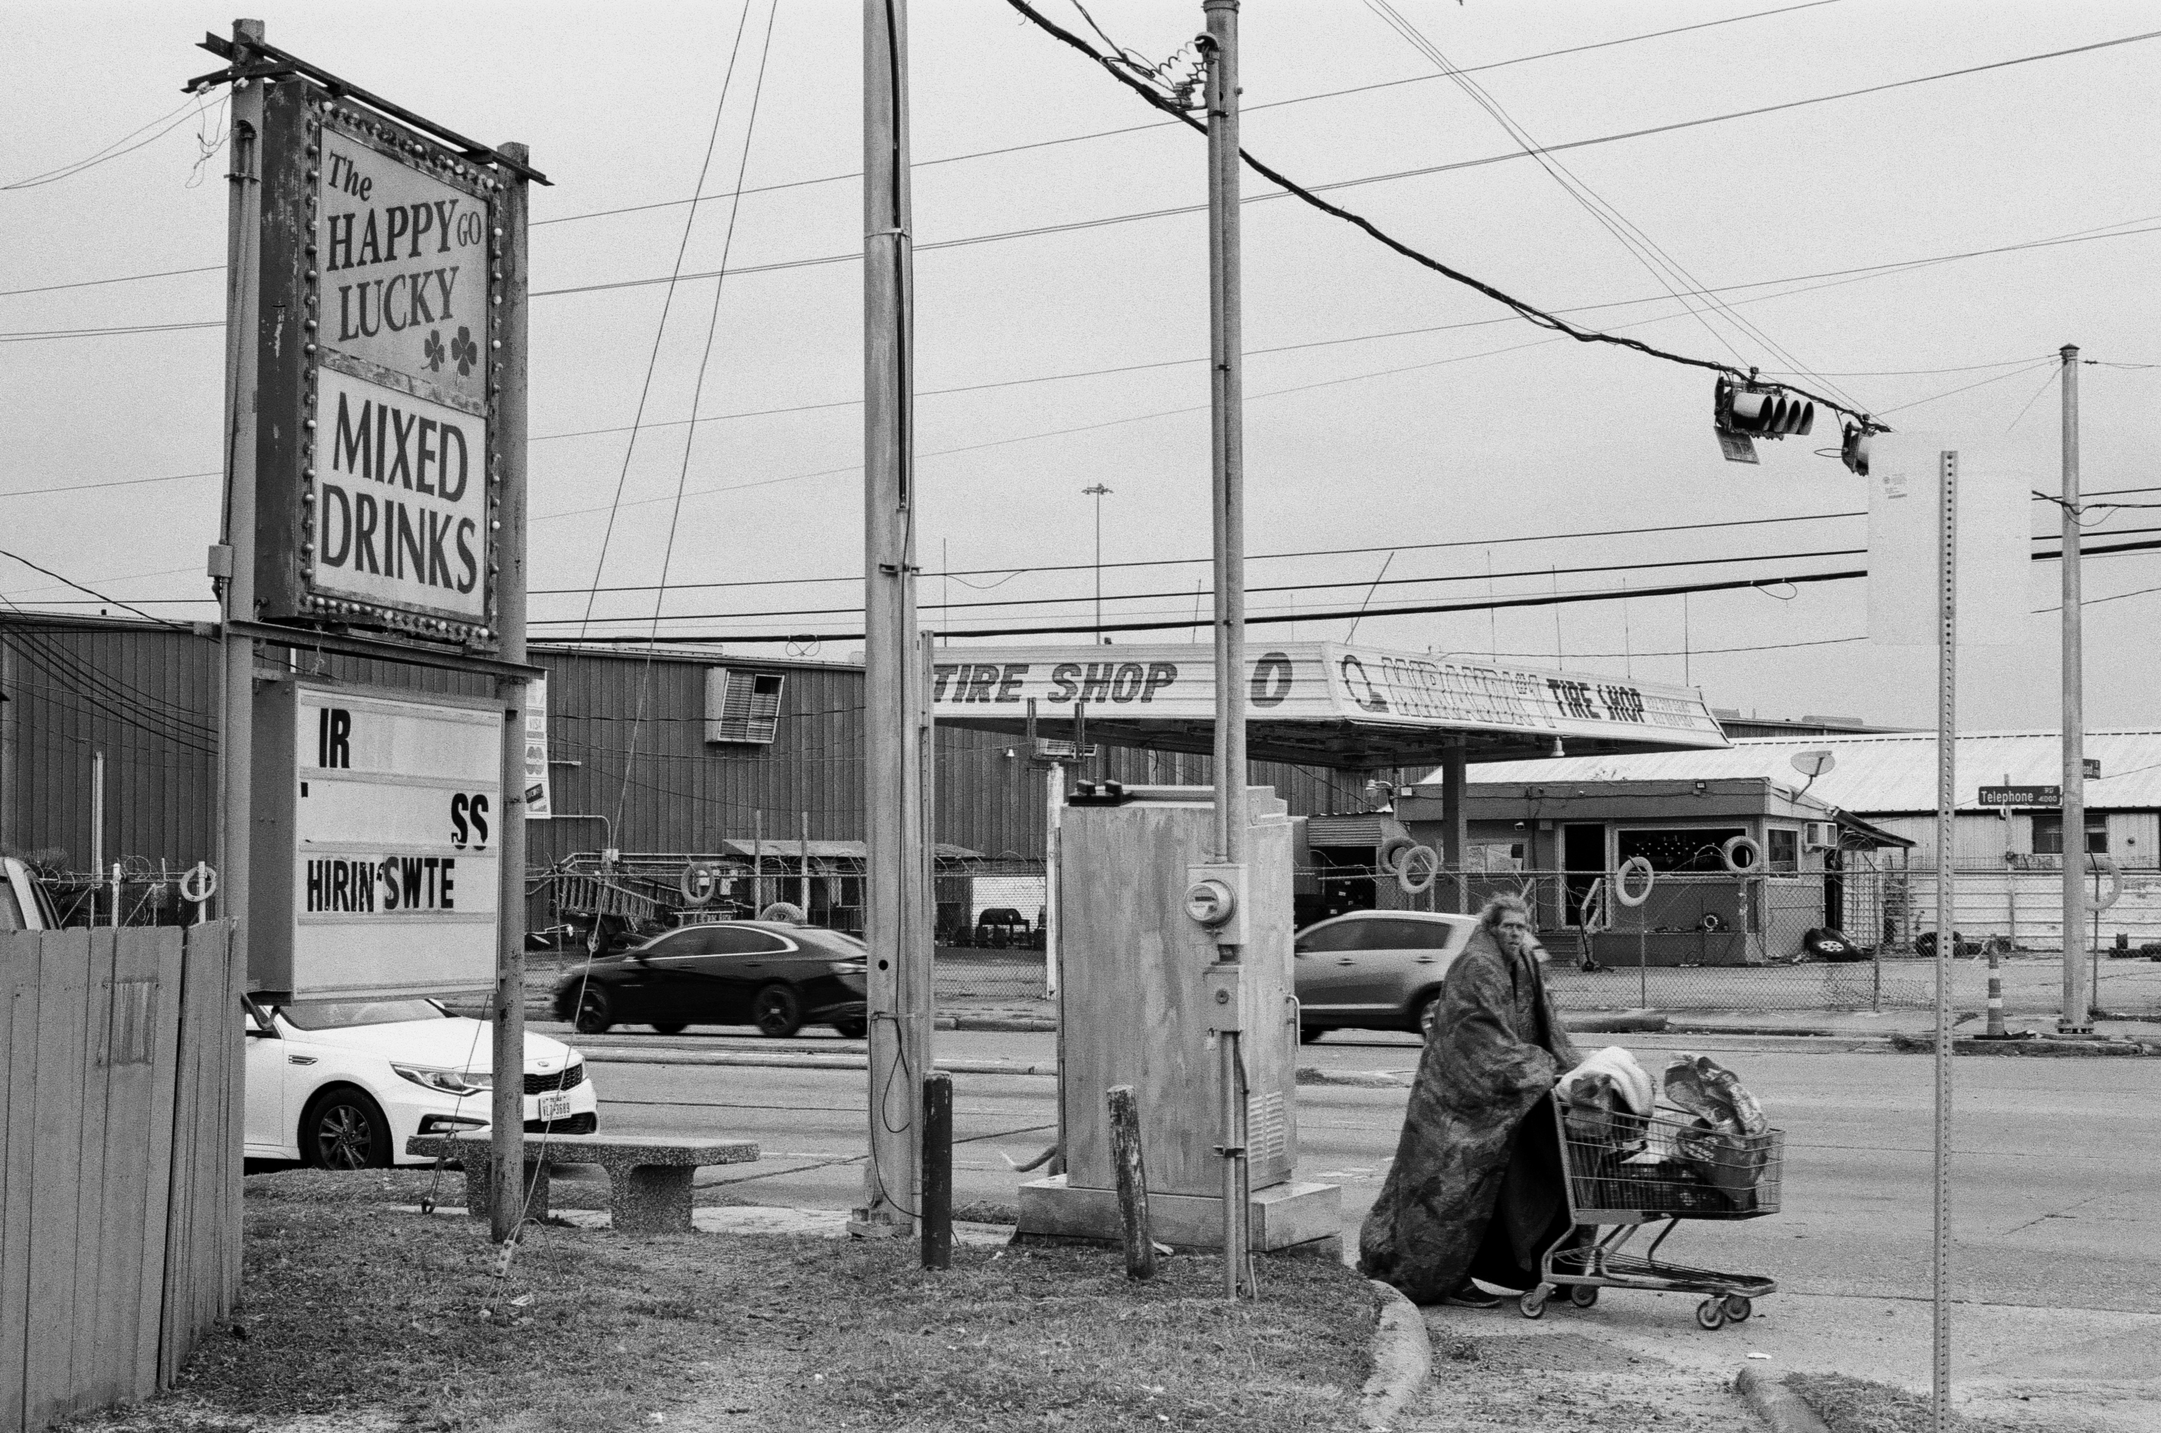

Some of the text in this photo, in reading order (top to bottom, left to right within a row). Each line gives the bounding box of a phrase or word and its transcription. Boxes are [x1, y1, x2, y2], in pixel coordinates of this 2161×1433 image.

[328, 151, 373, 202] The
[326, 199, 482, 272] HAPPY GO
[338, 265, 460, 342] LUCKY
[333, 391, 468, 502] MIXED
[321, 482, 477, 594] DRINKS
[933, 663, 1178, 704] TIRE SHOP
[1546, 678, 1602, 720] TIRE
[1597, 684, 1645, 723] SHOP
[318, 708, 351, 769] IR
[451, 793, 489, 851] SS
[1981, 790, 2034, 805] Telephone
